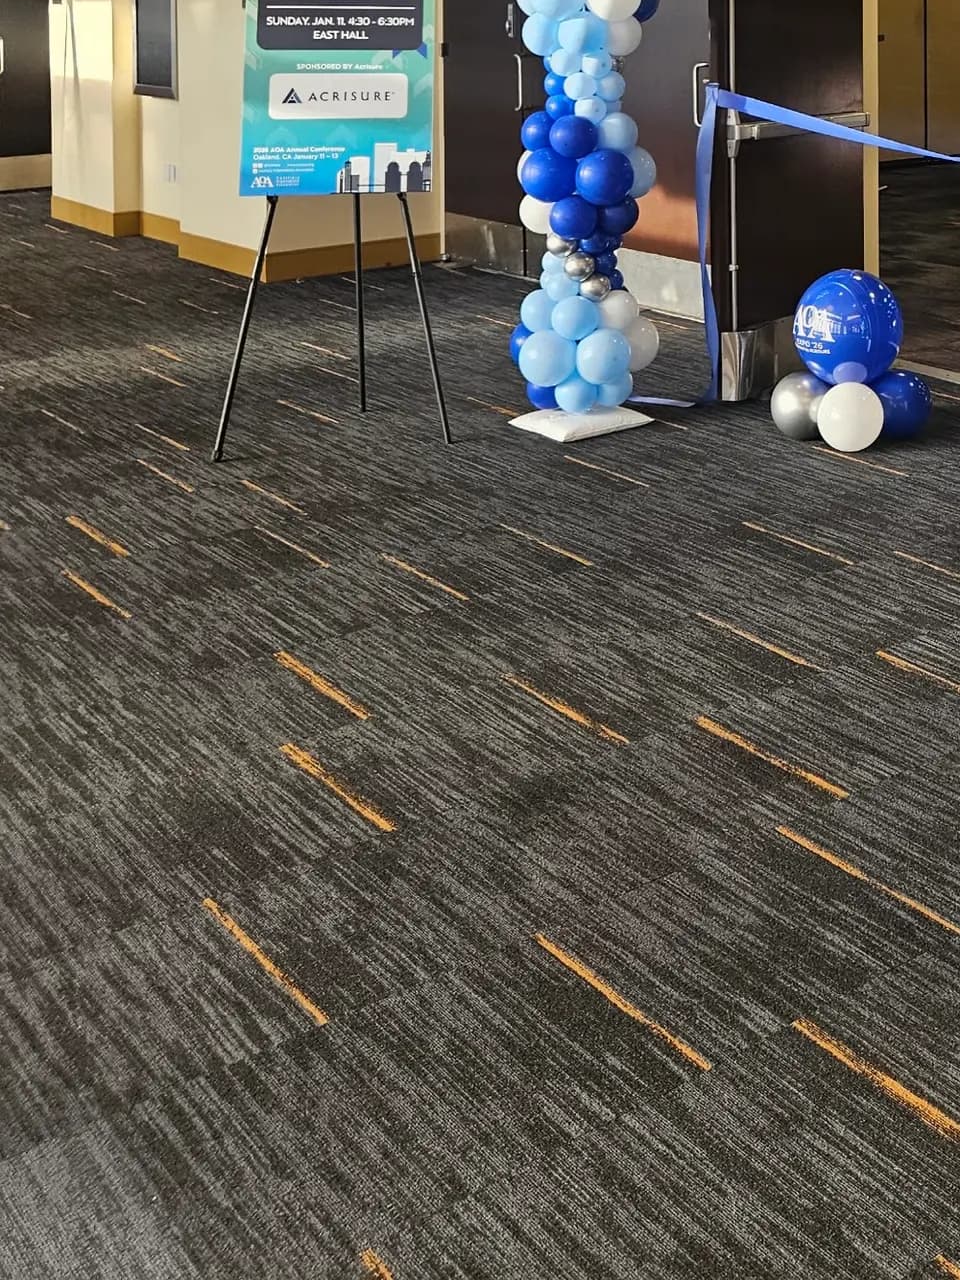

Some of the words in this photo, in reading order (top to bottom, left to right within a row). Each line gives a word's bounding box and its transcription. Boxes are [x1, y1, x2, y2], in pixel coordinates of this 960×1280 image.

[348, 17, 371, 26] 4:30
[377, 17, 415, 26] 6:30PM
[313, 30, 340, 40] EAST
[341, 30, 369, 40] HALL
[250, 176, 274, 188] AOA
